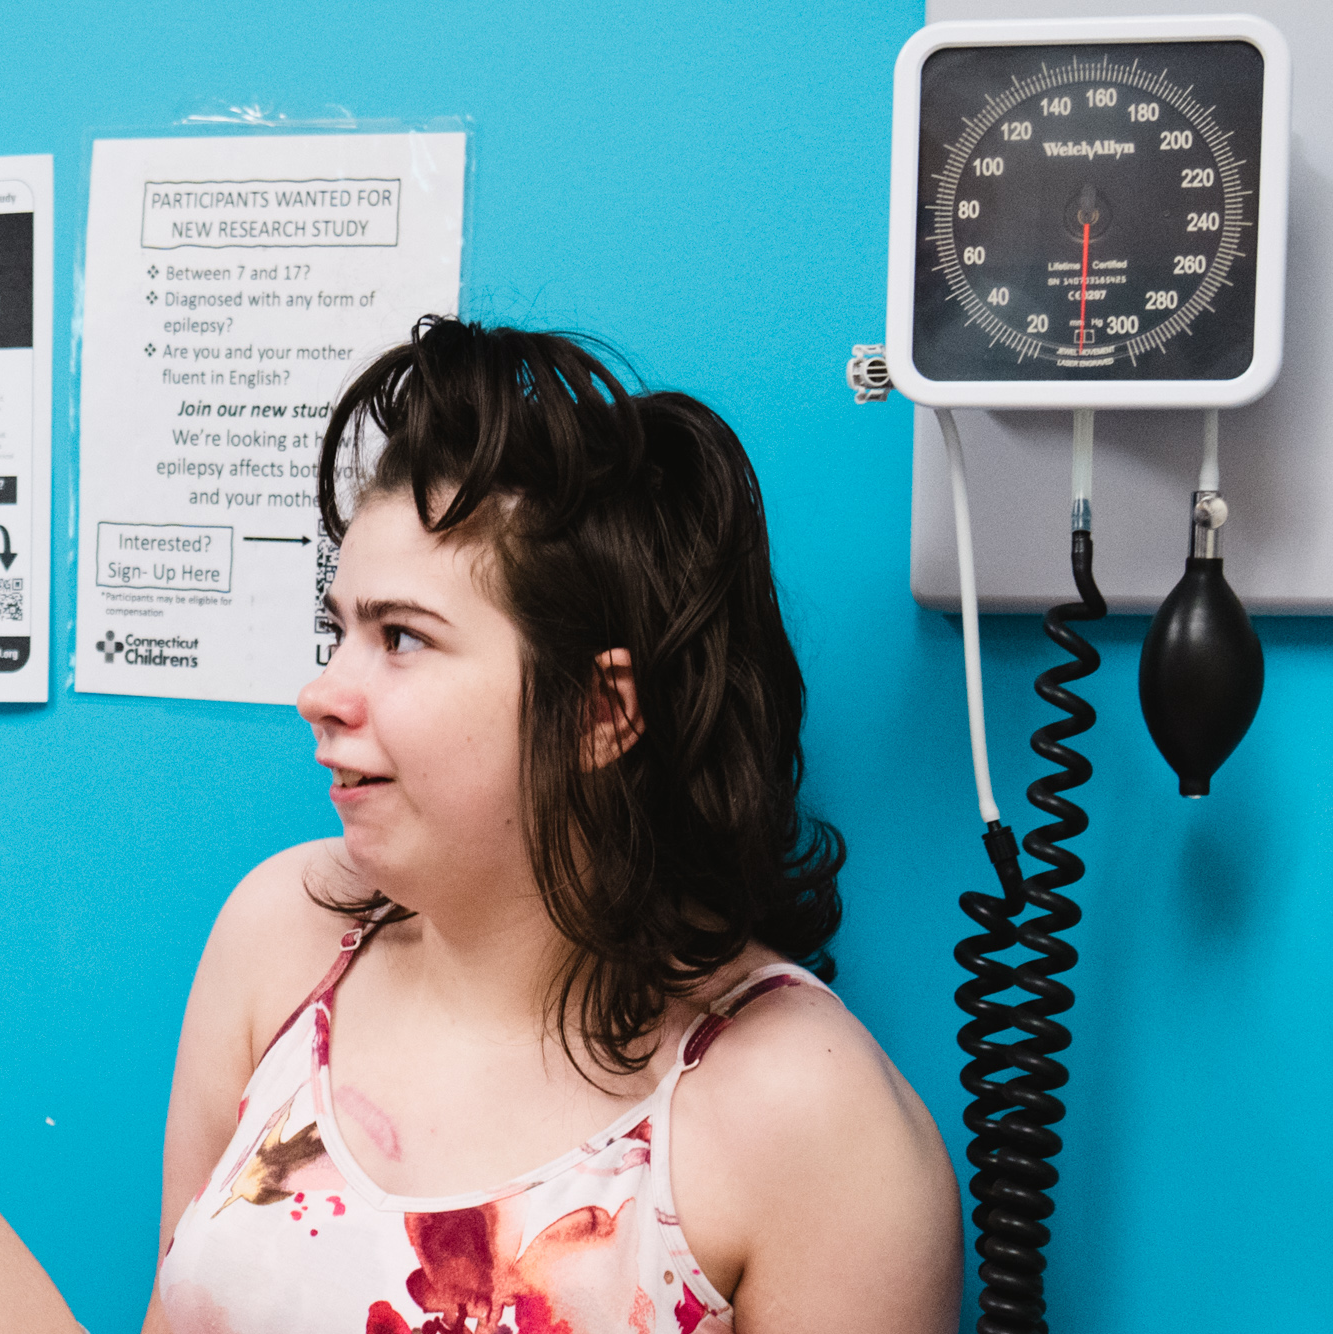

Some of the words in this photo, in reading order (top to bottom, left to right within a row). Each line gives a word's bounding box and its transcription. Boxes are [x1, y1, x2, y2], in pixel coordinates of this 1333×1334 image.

[1040, 97, 1071, 116] 140
[1086, 88, 1117, 107] 160
[1128, 103, 1159, 122] 180
[1001, 121, 1032, 141] 120
[1160, 130, 1193, 150] 200
[973, 157, 1004, 177] 100
[1181, 168, 1214, 188] 220
[151, 191, 269, 209] PARTICIPANTS
[275, 190, 351, 208] WANTED
[358, 189, 392, 207] FOR
[958, 200, 980, 219] 80
[172, 221, 213, 239] NEW
[218, 220, 306, 238] RESEARCH
[312, 219, 369, 237] STUDY
[1187, 212, 1220, 232] 240
[963, 246, 985, 265] 60
[1173, 255, 1206, 275] 260
[166, 265, 231, 281] Between
[236, 265, 246, 281] 7
[250, 265, 278, 281] and
[283, 264, 311, 281] 17?
[1048, 262, 1081, 271] Lifetime
[165, 291, 243, 311] Diagnosed
[248, 291, 281, 307] with
[285, 293, 313, 310] any
[317, 290, 354, 306] form
[359, 290, 377, 306] of
[987, 287, 1009, 306] 40
[1145, 291, 1178, 310] 280
[163, 317, 234, 336] epilepsy?
[1027, 314, 1049, 333] 20
[1106, 316, 1139, 334] 300
[163, 344, 189, 360] Are
[192, 347, 220, 363] you
[225, 344, 253, 360] and
[257, 346, 291, 363] your
[296, 344, 353, 360] mother
[163, 368, 206, 386] fluent
[211, 370, 224, 385] in
[229, 369, 290, 389] English?
[177, 400, 211, 417] Join
[217, 403, 246, 418] our
[250, 403, 287, 418] new
[226, 429, 287, 452] looking
[292, 432, 309, 448] at
[315, 430, 352, 448] hw
[156, 457, 225, 479] epilepsy
[229, 458, 284, 478] affects
[289, 460, 318, 478] bot
[189, 488, 219, 505] and
[225, 492, 263, 509] your
[268, 490, 320, 508] mothe
[118, 533, 212, 553] Interested?
[107, 562, 148, 583] Sign-
[153, 563, 176, 584] Up
[181, 564, 221, 582] Here
[156, 595, 174, 605] may
[175, 594, 187, 604] be
[188, 595, 218, 607] eligible
[220, 596, 233, 606] for
[105, 607, 164, 618] compensation
[125, 634, 199, 650] Connecticut
